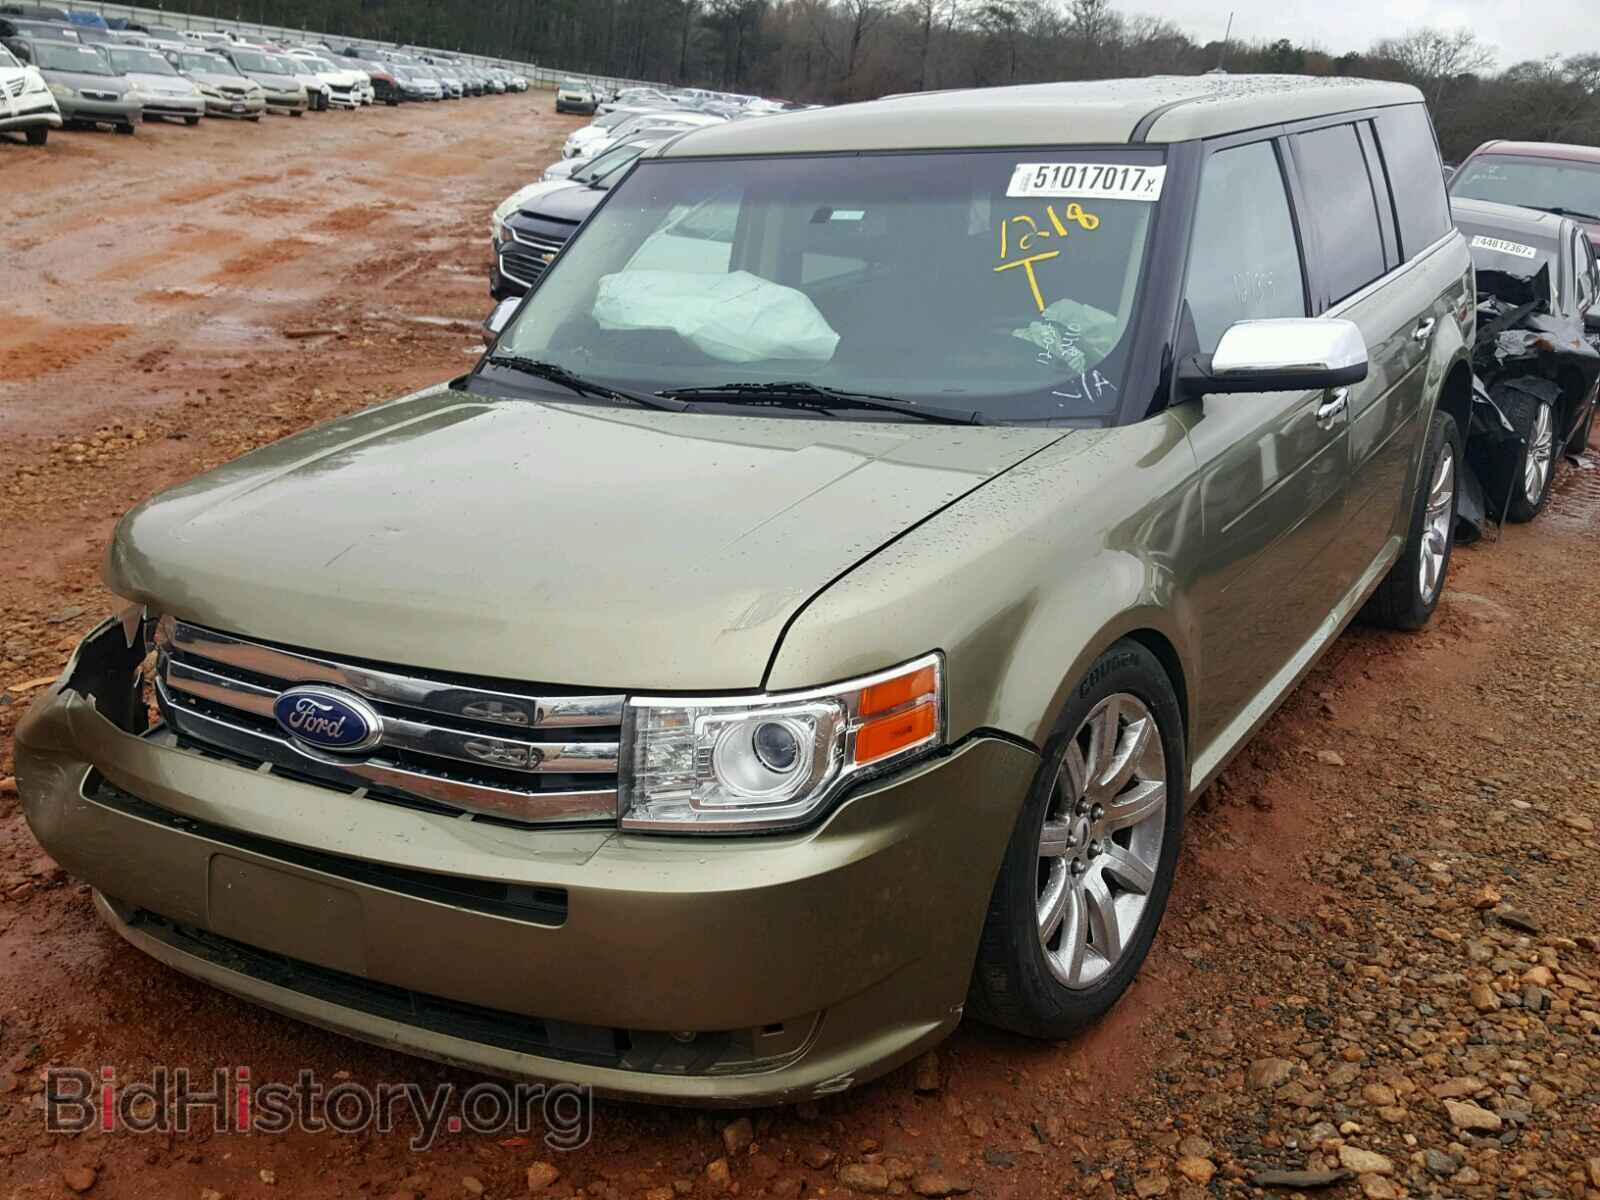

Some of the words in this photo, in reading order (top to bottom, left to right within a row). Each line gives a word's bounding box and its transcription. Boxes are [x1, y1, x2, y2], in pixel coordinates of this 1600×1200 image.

[1033, 165, 1146, 192] 51017017
[1000, 202, 1100, 259] 1218
[288, 697, 347, 739] Ford
